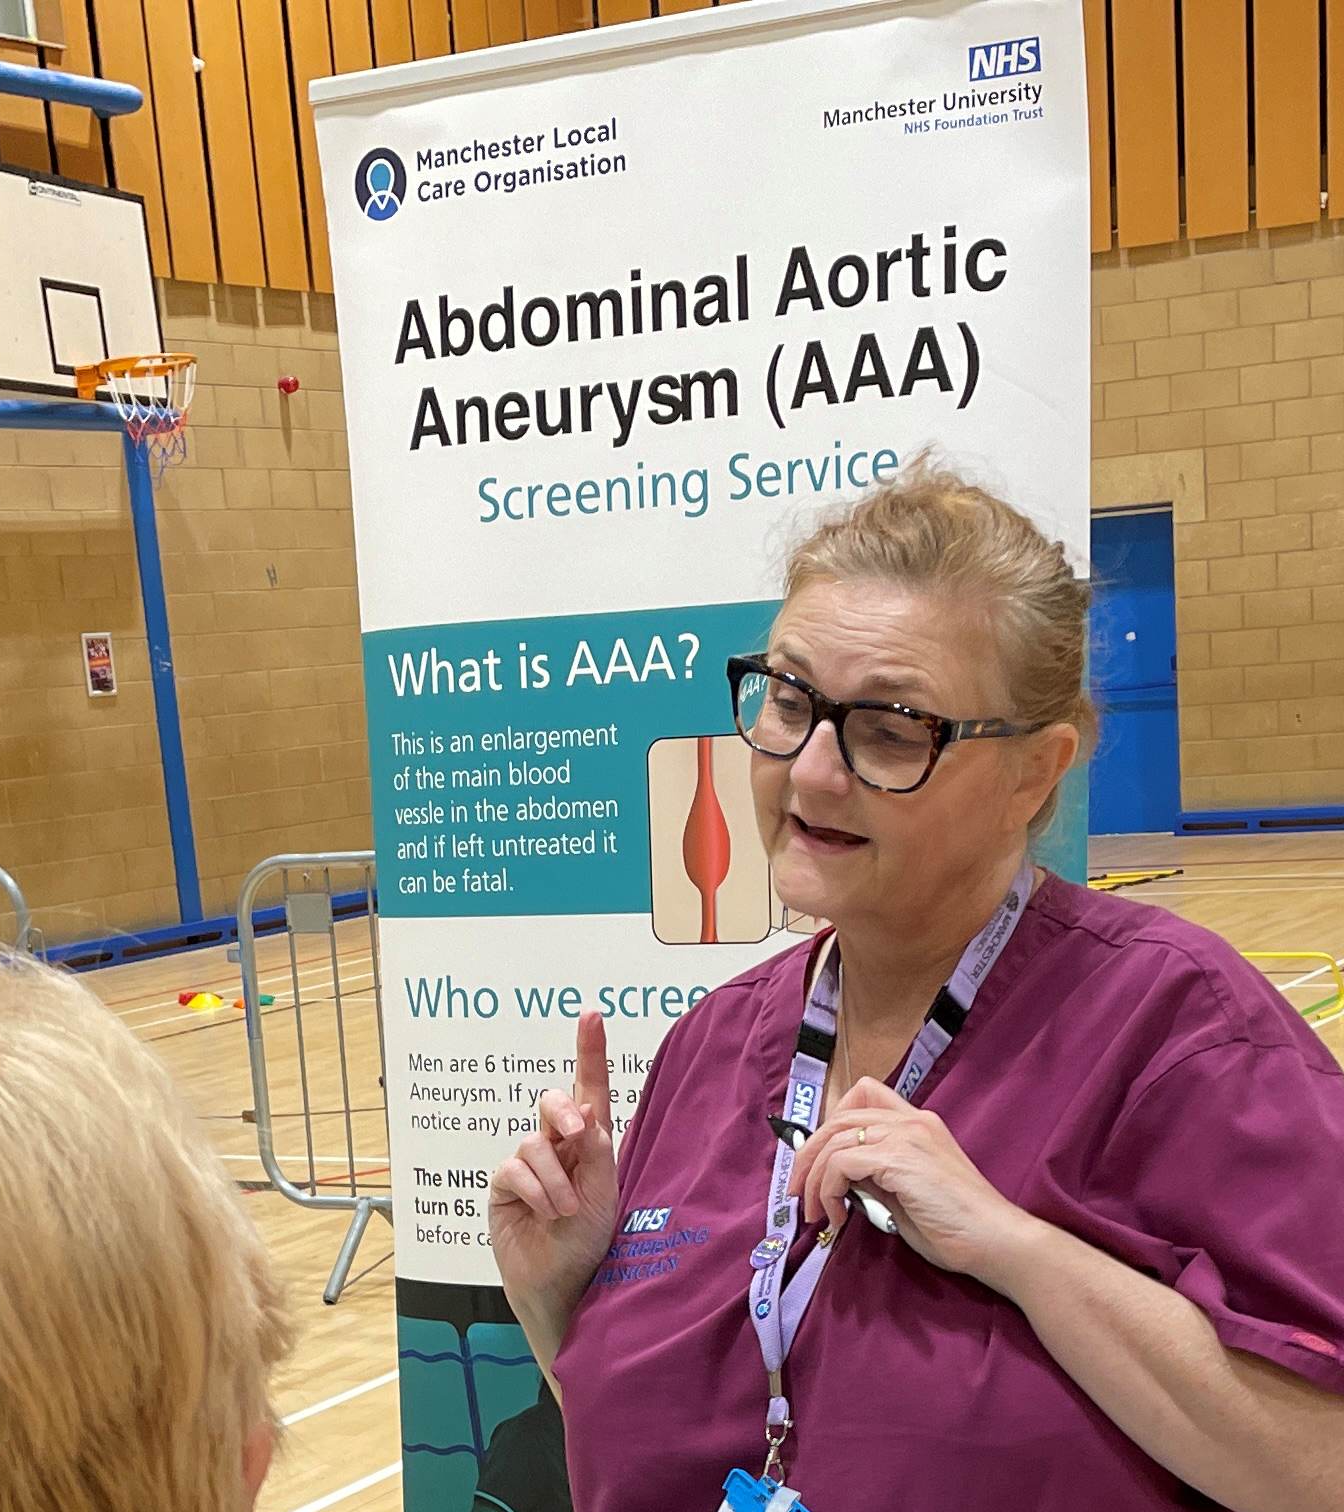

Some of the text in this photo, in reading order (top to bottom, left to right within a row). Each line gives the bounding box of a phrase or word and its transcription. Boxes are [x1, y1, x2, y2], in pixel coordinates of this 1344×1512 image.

[969, 37, 1041, 81] NHS
[823, 81, 1044, 134] Manchester University
[904, 106, 1044, 135] NHS Foundation Trust
[416, 116, 617, 172] Manchester Local
[417, 153, 626, 203] Care Organisation
[394, 224, 1008, 365] Abdominal Aortic
[409, 321, 980, 451] Aneurysm (AAA)
[478, 440, 904, 523] Screening Service
[387, 632, 700, 697] What is AAA?
[391, 723, 619, 756] This enlargement
[451, 758, 571, 788] main blood
[394, 795, 619, 825] vessle abdomen
[452, 829, 596, 858] left untreated
[461, 867, 514, 893] fatal.
[970, 914, 1012, 979] MANCHESTER
[404, 974, 710, 1019] Who we scree
[408, 1053, 444, 1073] Men
[501, 1053, 556, 1074] times
[622, 1053, 654, 1074] like
[409, 1082, 502, 1107] Aneurysm.
[791, 1083, 816, 1127] NHS
[411, 1112, 540, 1137] notice any pai
[413, 1167, 489, 1189] The NHS
[414, 1196, 481, 1218] turn 65.
[624, 1208, 672, 1232] NHS
[416, 1223, 471, 1246] before
